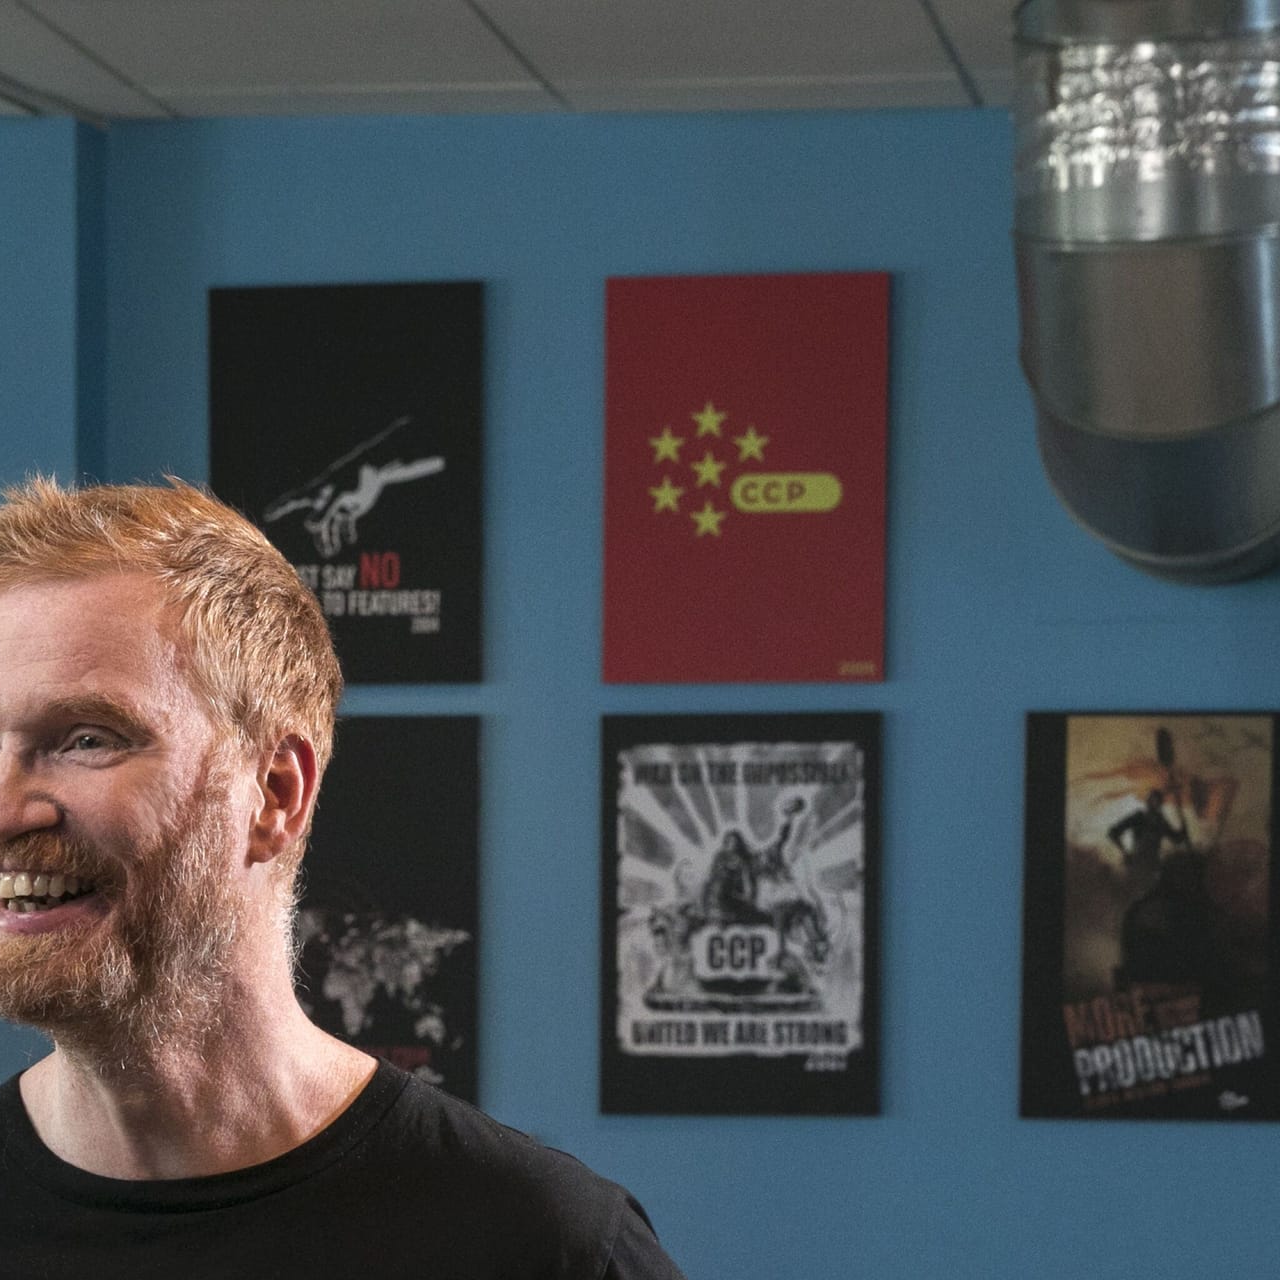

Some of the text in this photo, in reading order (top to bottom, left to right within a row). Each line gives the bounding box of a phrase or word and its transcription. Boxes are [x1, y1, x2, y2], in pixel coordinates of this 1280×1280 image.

[740, 481, 807, 505] CCP
[321, 563, 357, 590] SAY
[359, 551, 402, 590] NO
[347, 589, 442, 617] FEATURES!
[707, 934, 767, 970] CCP
[631, 1020, 848, 1046] UNITED WE ARE STRONG
[1073, 1009, 1266, 1096] PRODUCTION
